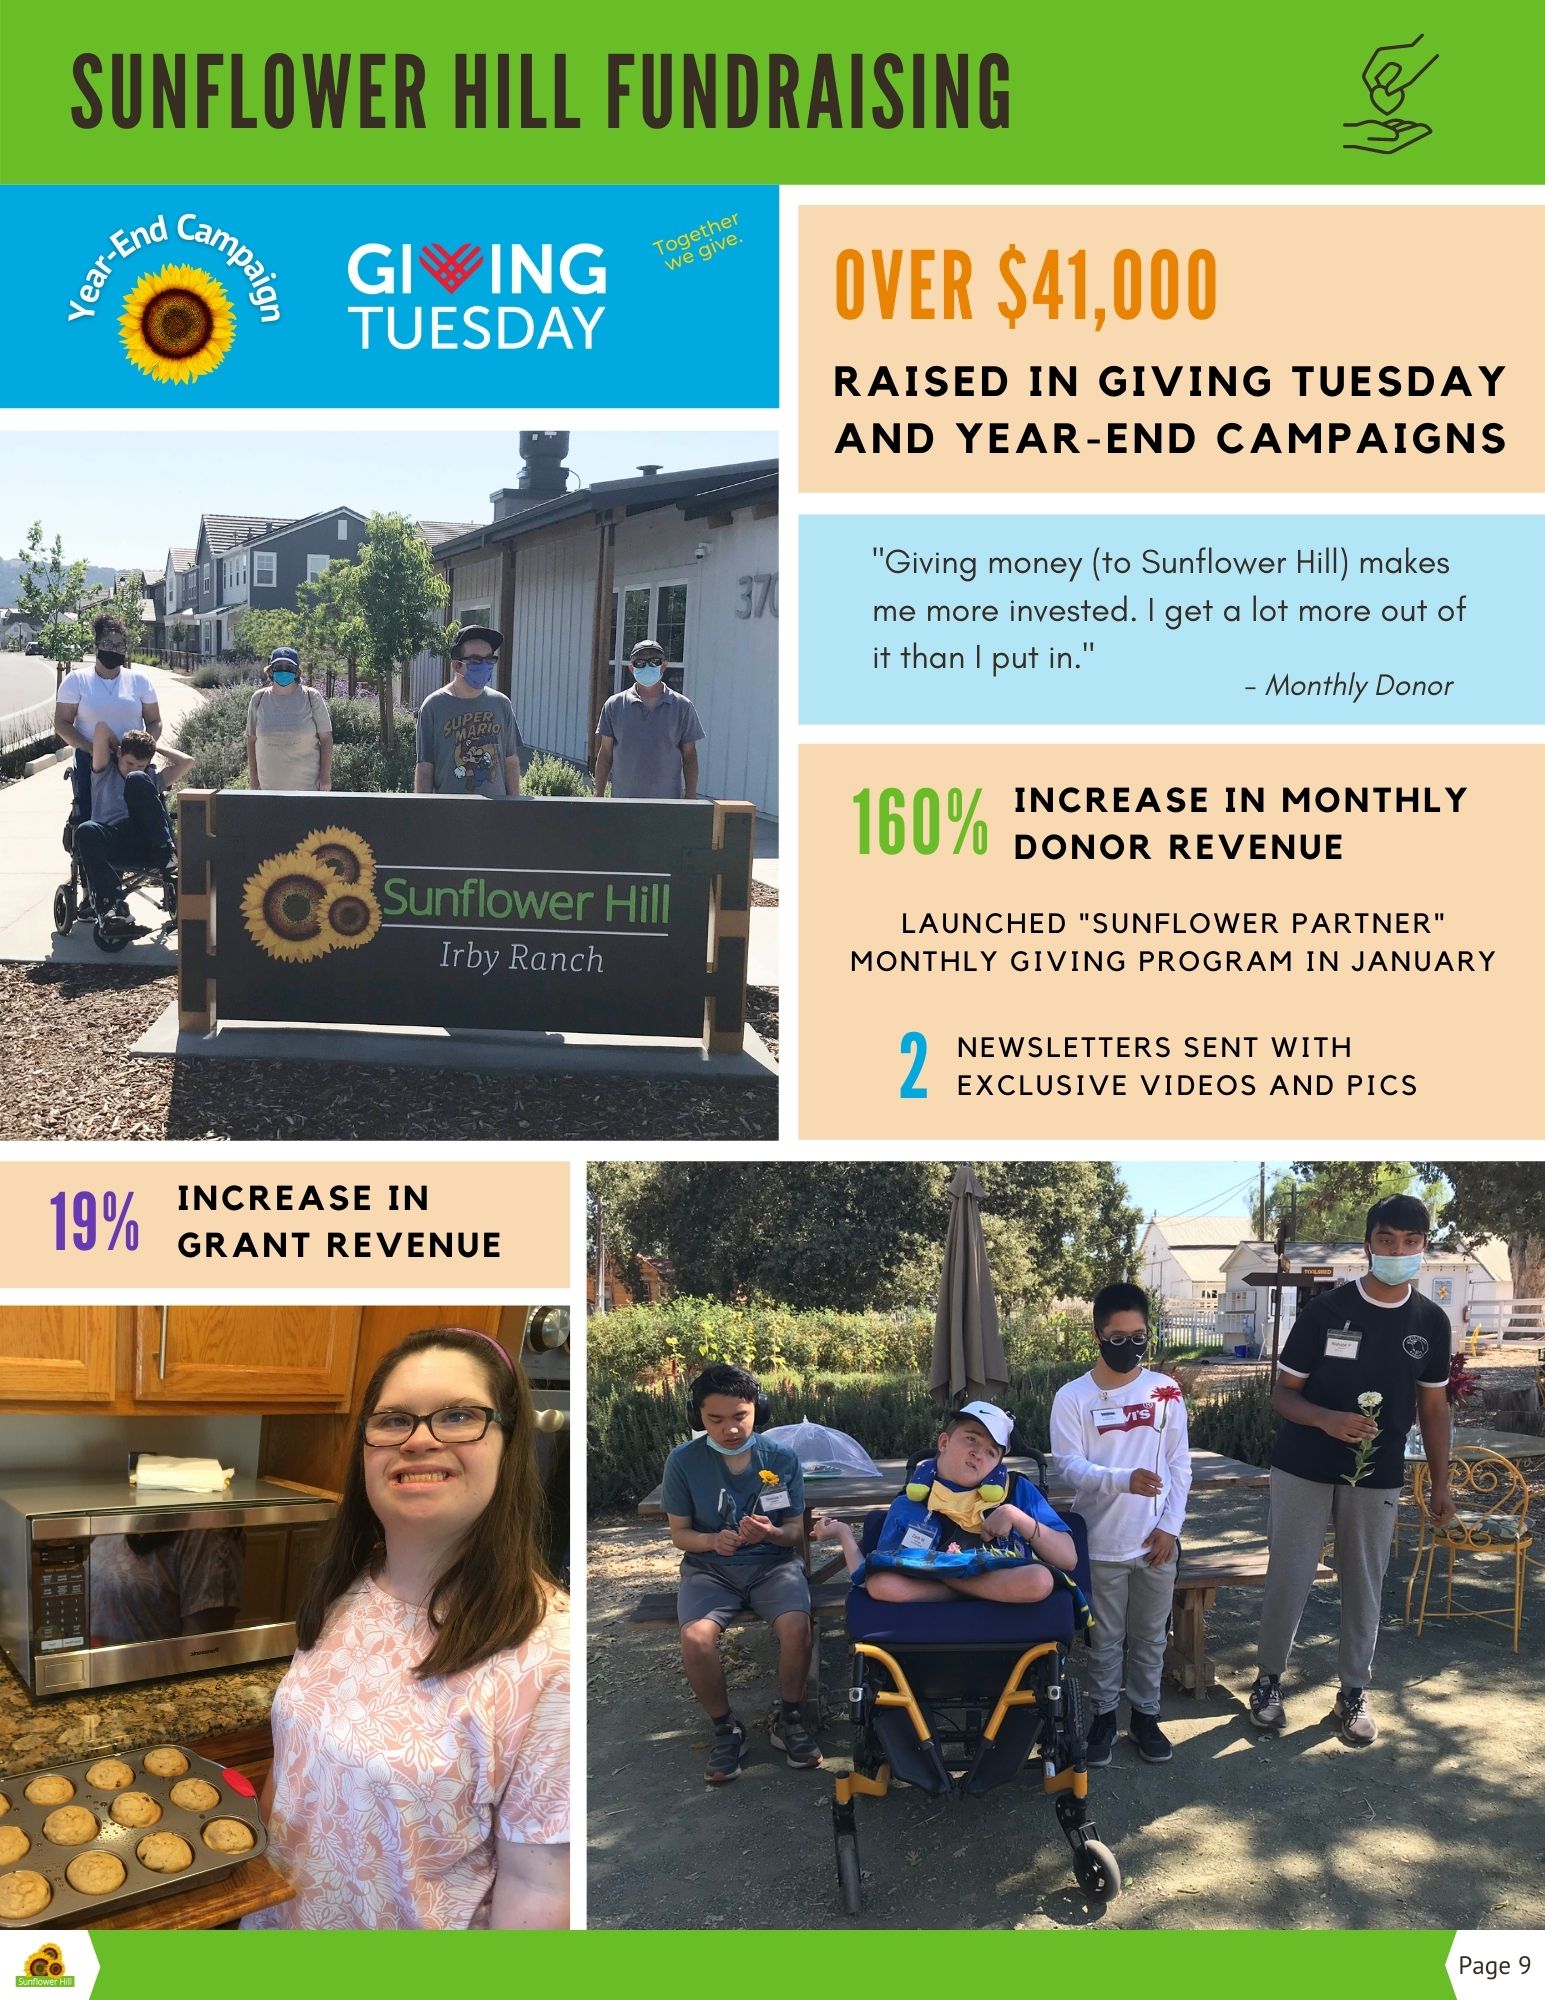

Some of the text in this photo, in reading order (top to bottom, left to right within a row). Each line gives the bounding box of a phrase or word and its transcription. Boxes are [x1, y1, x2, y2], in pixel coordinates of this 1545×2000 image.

[71, 51, 1009, 129] SUNFLOWER HILL FUNDRAISING
[652, 212, 739, 256] Together
[67, 213, 281, 323] Year-End Campaign
[664, 234, 743, 271] we give.
[836, 243, 1216, 332] OVER $41,000
[347, 305, 606, 351] TUESDAY
[835, 365, 1506, 398] RAISED IN GIVING TUESDAY
[834, 422, 1505, 455] AND YEAR-END CAMPAIGNS
[873, 547, 1449, 582] "Giving money (to Sunflower Hill) makes
[874, 595, 1467, 630] me more invested. I get a lot more out of
[874, 642, 1094, 677] it than I put in."
[1265, 672, 1368, 703] Monthly
[1376, 674, 1454, 696] Donor
[443, 711, 494, 737] SUPER
[455, 723, 501, 741] MARIO
[1015, 787, 1468, 813] INCREASE IN MONTHLY
[852, 787, 988, 855] 160%
[1015, 833, 1342, 860] DONOR REVENUE
[383, 877, 670, 924] Sunflower Hill
[902, 912, 1444, 935] LAUNCHED "SUNFLOWER PARTNER"
[439, 941, 605, 976] Irby Ranch
[852, 951, 1495, 972] MONTHLY GIVING PROGRAM IN JANUARY
[958, 1034, 1350, 1058] NEWSLETTERS SENT WITH
[899, 1030, 928, 1100] 2
[958, 1073, 1416, 1096] EXCLUSIVE VIDEOS AND PICS
[178, 1185, 427, 1212] INCREASE IN
[50, 1190, 139, 1252] 19%
[178, 1232, 500, 1259] GRANT REVENUE
[18, 1977, 72, 1986] Sunflower Hill
[1459, 1955, 1532, 1980] Page 9
